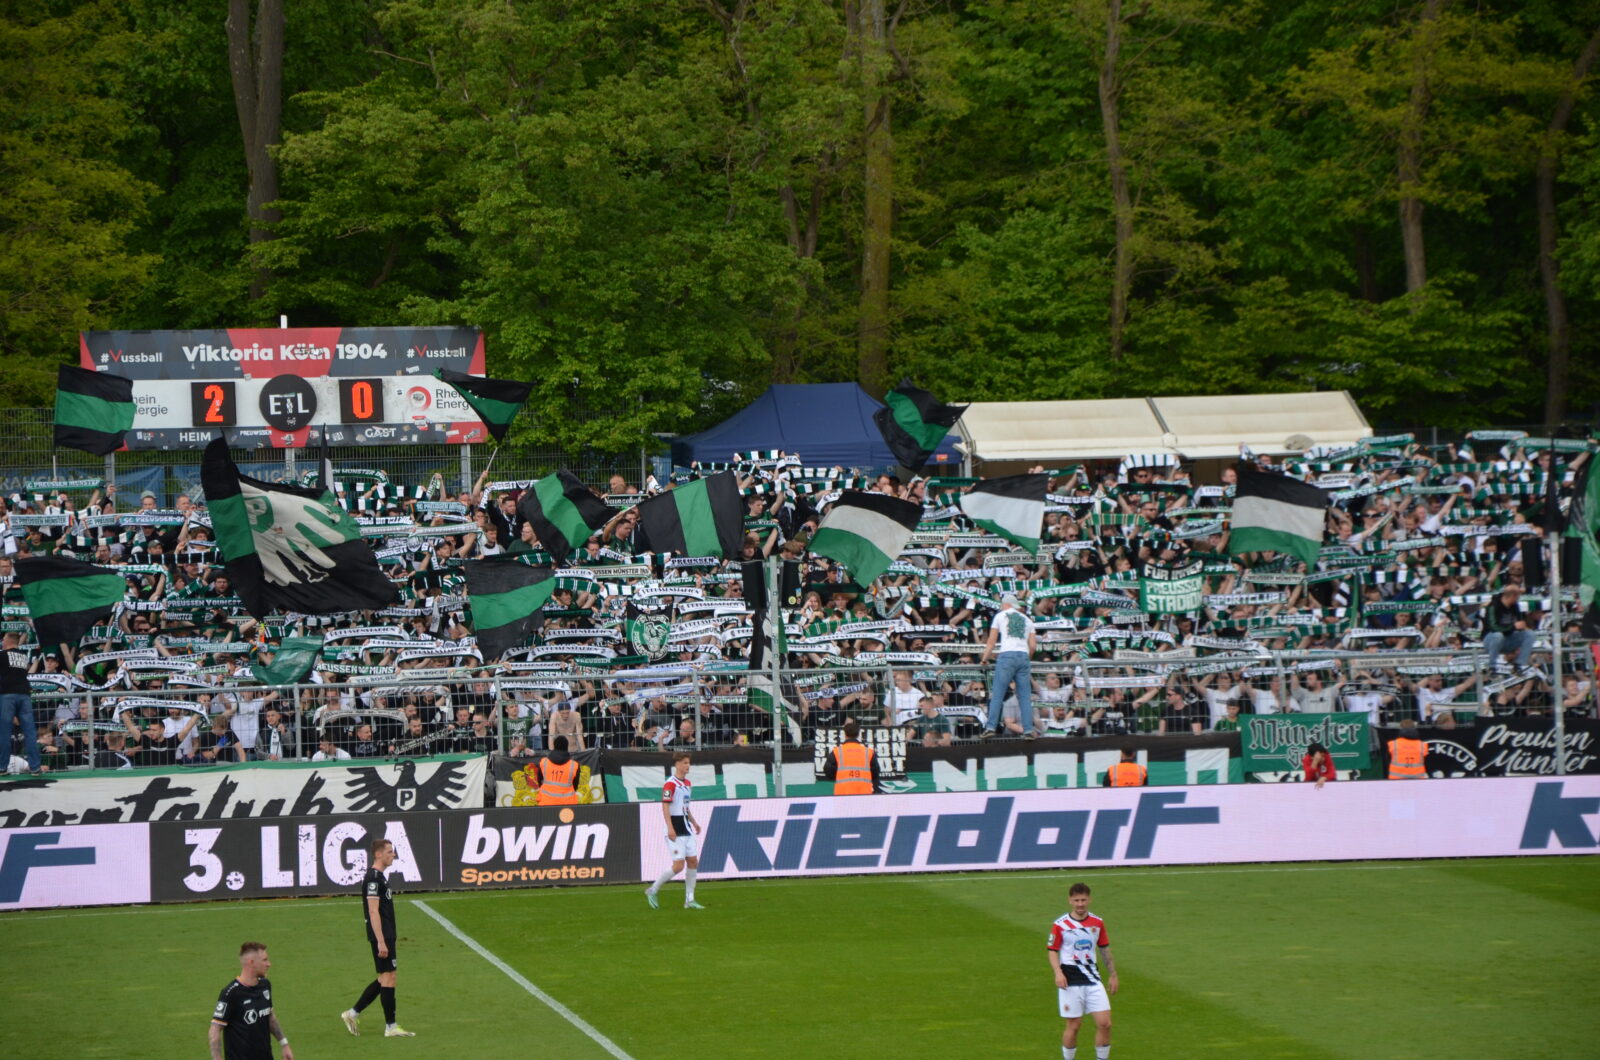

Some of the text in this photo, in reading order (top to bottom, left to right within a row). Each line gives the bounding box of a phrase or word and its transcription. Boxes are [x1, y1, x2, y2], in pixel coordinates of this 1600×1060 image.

[100, 349, 163, 363] #Vussball
[181, 342, 274, 363] Viktoria
[335, 342, 388, 360] 1904
[133, 394, 157, 405] hein
[136, 405, 168, 416] ergie
[203, 384, 224, 423] 2
[351, 381, 374, 419] 0
[436, 399, 470, 411] Energ
[179, 431, 211, 442] HEIM
[364, 427, 397, 438] GAST
[1249, 714, 1362, 753] Münster
[1427, 740, 1478, 772] -KLUB
[461, 807, 610, 865] bwin
[699, 791, 1220, 874] kierdorf
[183, 820, 422, 892] 3. LIGA
[460, 864, 605, 886] Sportwetten
